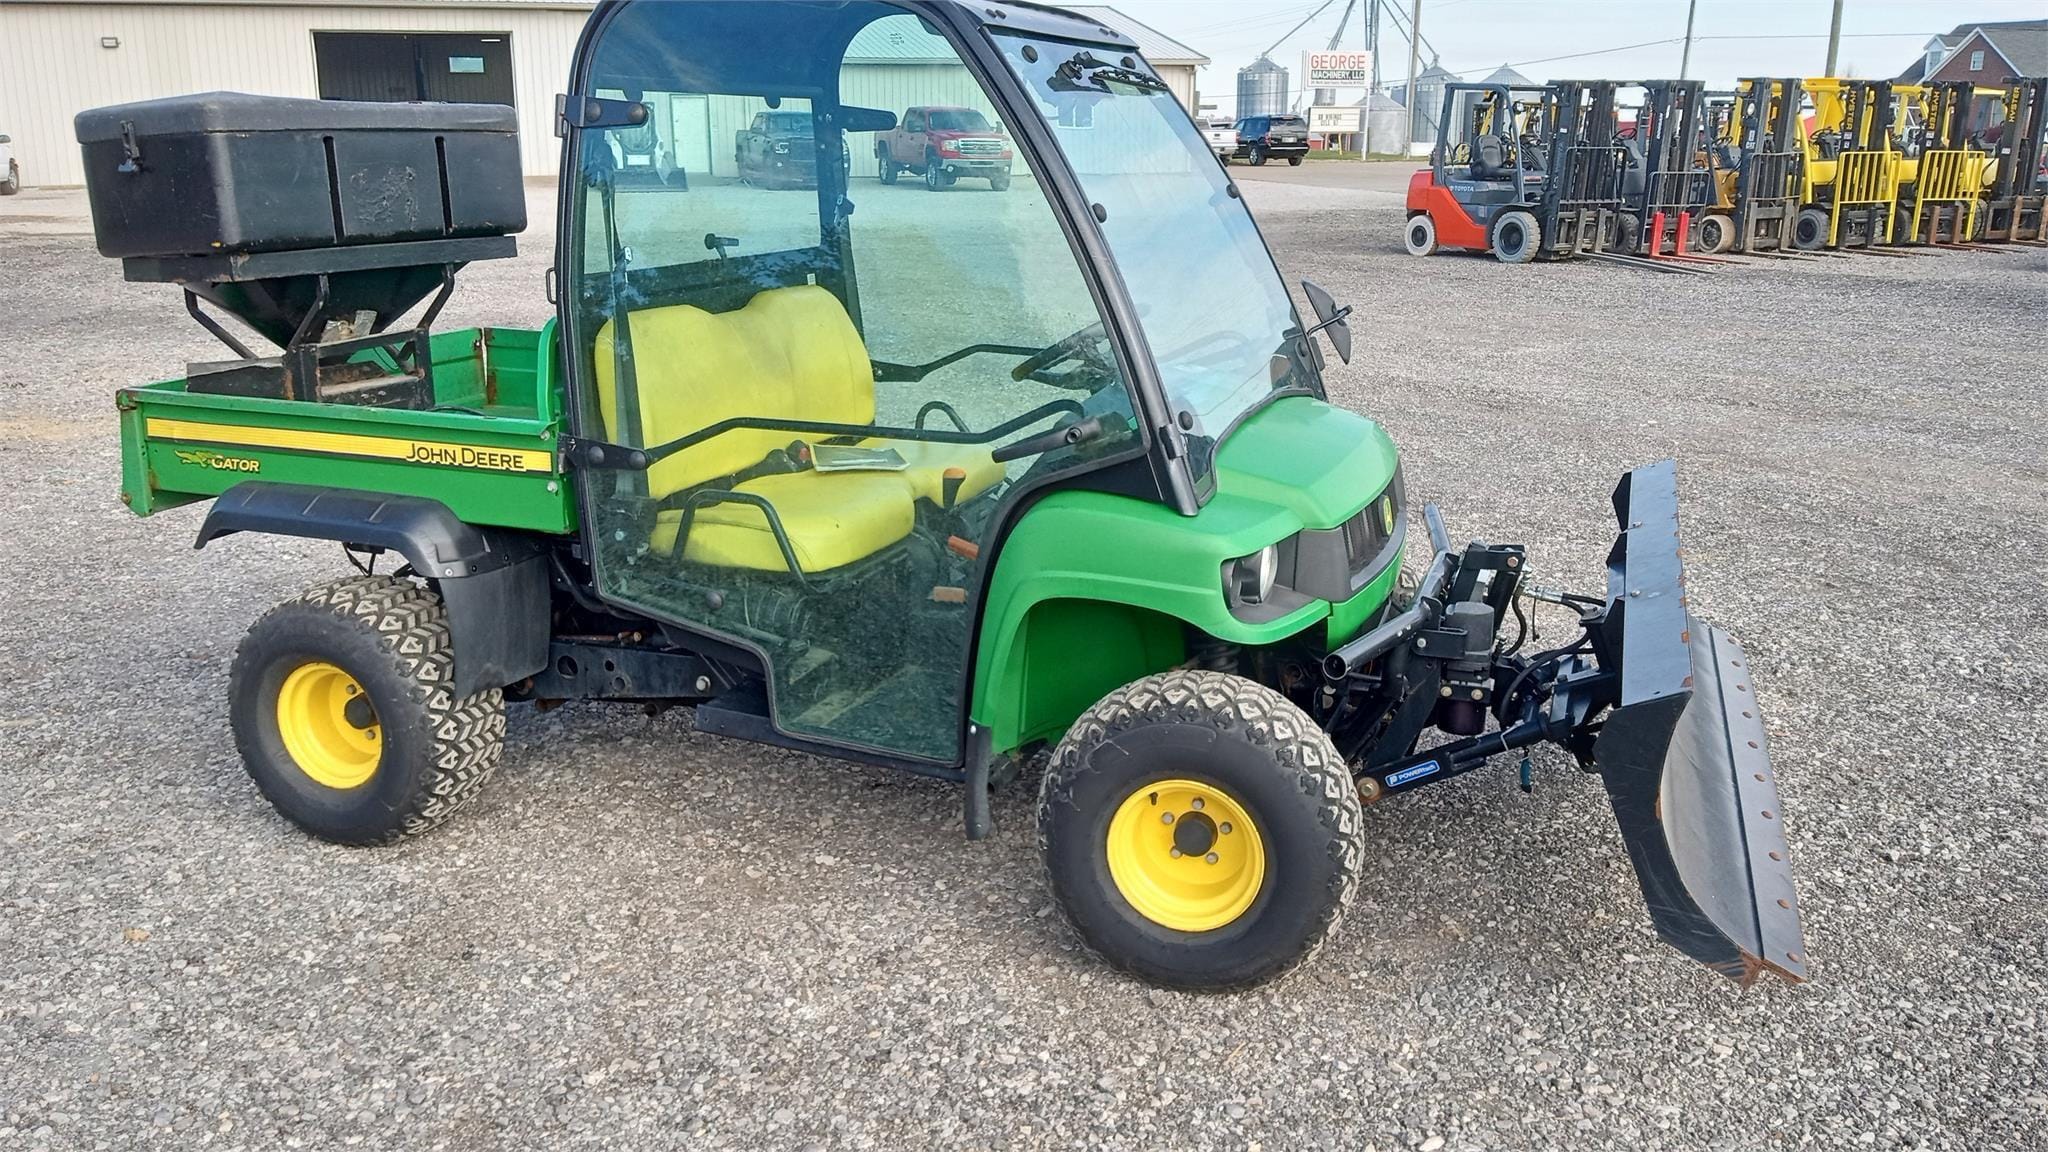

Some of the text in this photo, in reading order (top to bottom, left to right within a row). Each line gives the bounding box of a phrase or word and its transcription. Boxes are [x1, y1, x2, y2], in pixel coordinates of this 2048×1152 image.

[1311, 54, 1366, 69] GEORGE
[1352, 70, 1365, 80] LLC
[1846, 89, 1857, 130] HYSTER
[1929, 91, 1941, 130] HYSTER
[2008, 86, 2020, 123] HYSTER
[211, 456, 261, 473] GATOR
[406, 443, 525, 469] JOHN DEERE
